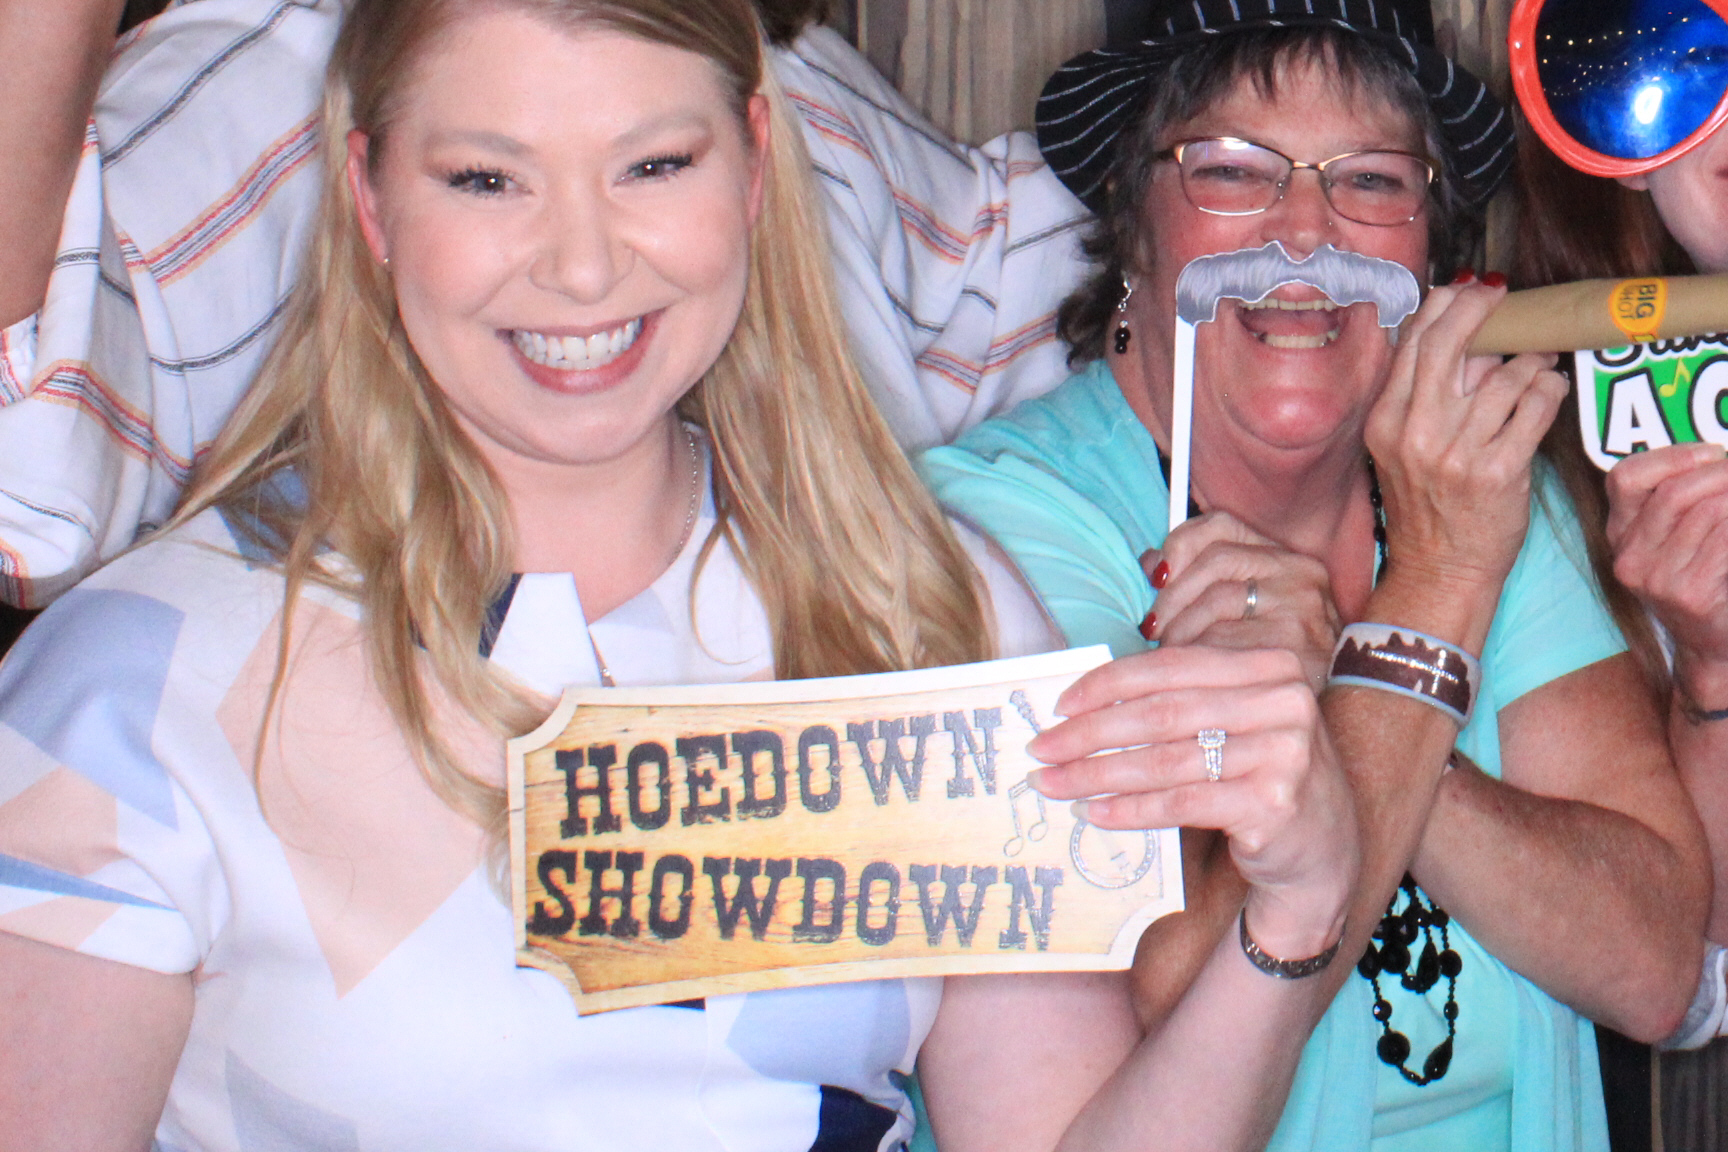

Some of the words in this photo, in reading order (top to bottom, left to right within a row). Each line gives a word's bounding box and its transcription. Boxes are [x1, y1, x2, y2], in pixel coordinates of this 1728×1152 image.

[1635, 284, 1658, 319] BIG
[1602, 367, 1675, 456] A
[554, 707, 1004, 839] HOEDOWN
[525, 849, 1065, 951] SHOWDOWN
